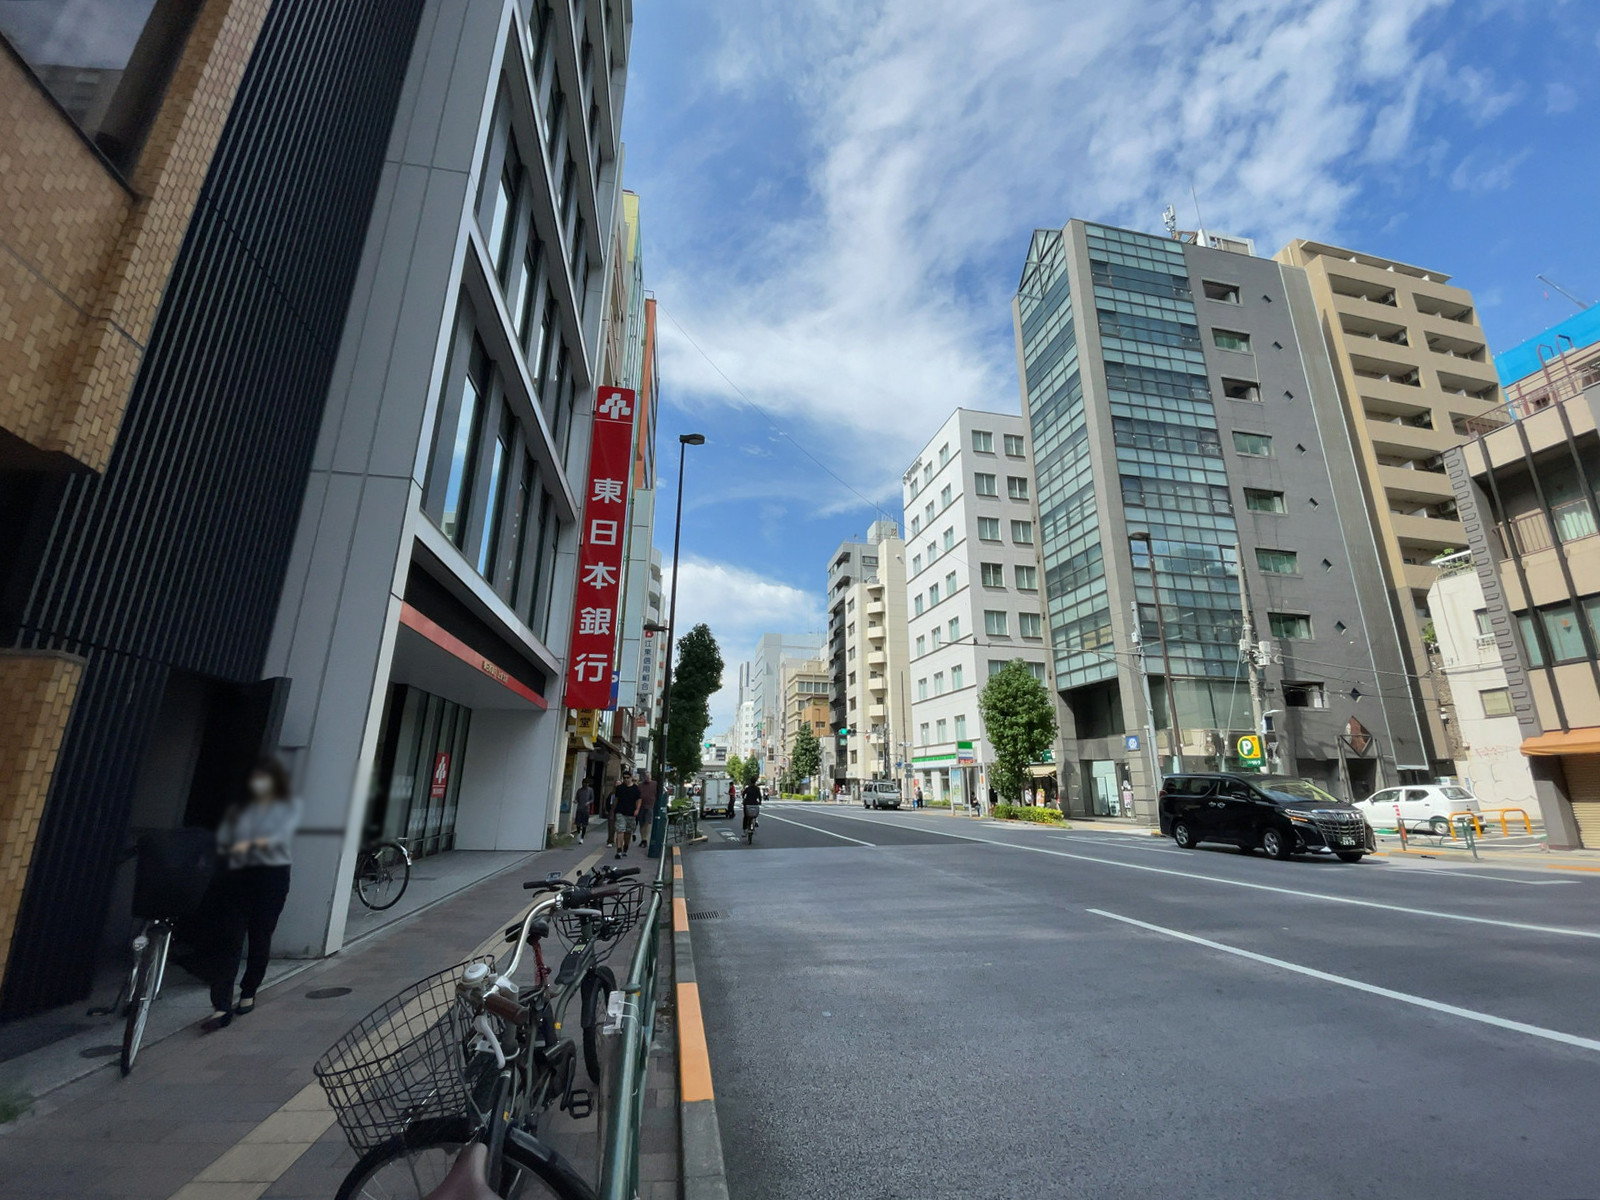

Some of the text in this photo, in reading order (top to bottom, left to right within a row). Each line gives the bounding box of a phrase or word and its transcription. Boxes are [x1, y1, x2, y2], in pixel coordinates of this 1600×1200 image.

[574, 478, 623, 682] 東日本銀行
[1241, 740, 1252, 755] P
